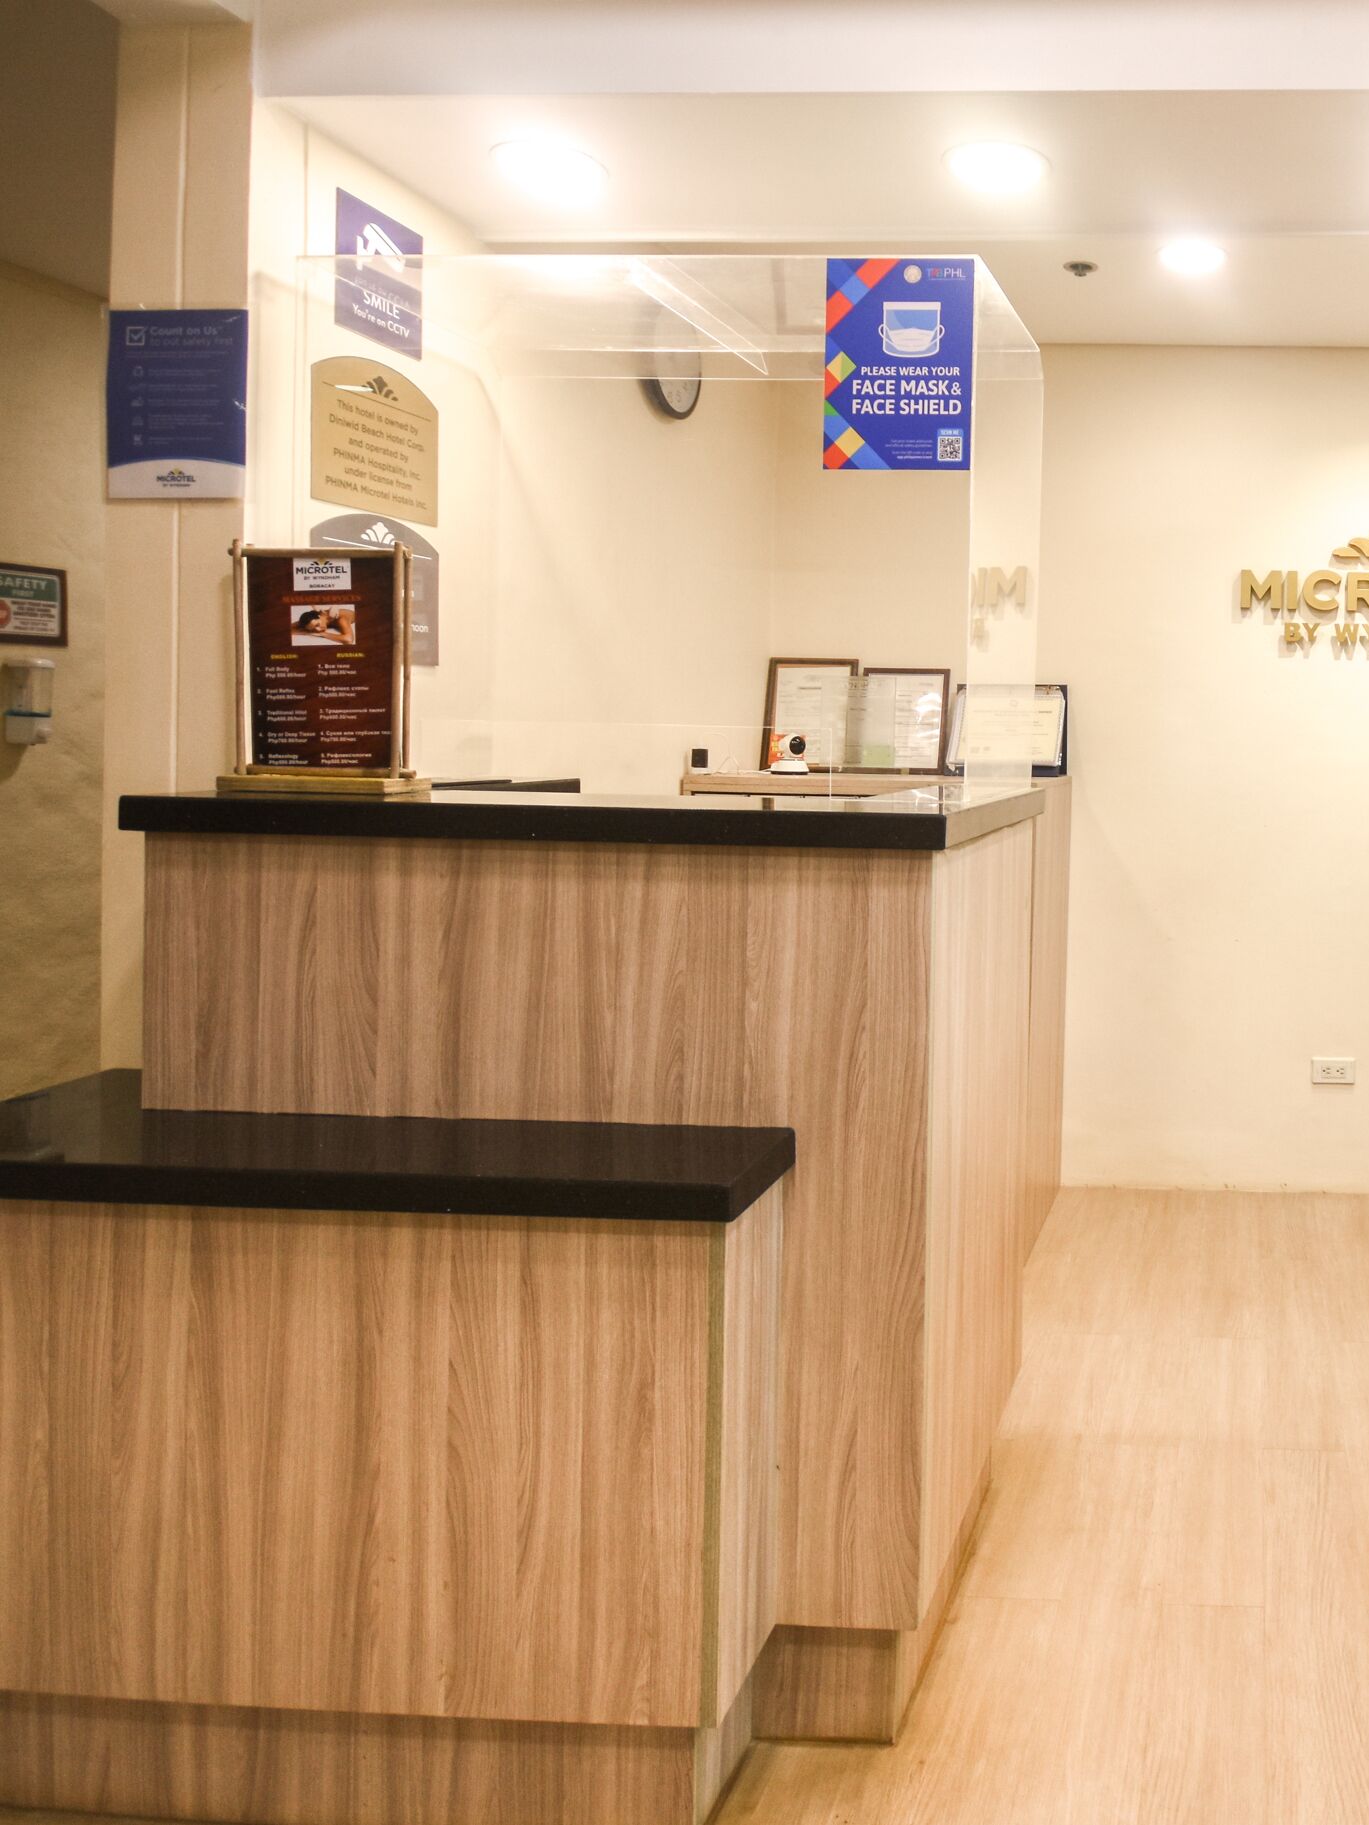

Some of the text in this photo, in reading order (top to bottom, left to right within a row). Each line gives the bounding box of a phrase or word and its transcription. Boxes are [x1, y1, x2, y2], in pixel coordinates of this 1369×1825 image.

[363, 290, 400, 320] SMILE
[150, 326, 182, 336] Count
[186, 328, 200, 336] on
[352, 304, 410, 338] You're on CCTV
[861, 366, 960, 376] PLEASE WEAR YOUR
[852, 380, 962, 395] FACE MASK &
[336, 399, 418, 436] This hotel is owned by
[852, 399, 962, 415] FACE SHIELD
[329, 413, 359, 431] Diniwid
[361, 424, 384, 439] Beach
[386, 432, 405, 445] Hotel
[333, 448, 365, 464] PHINMA
[348, 437, 409, 463] and operated by
[344, 466, 412, 491] under license from
[325, 475, 358, 493] PHINMA
[360, 485, 390, 500] Microtel
[392, 494, 414, 506] Hotels
[296, 566, 347, 575] MICROTEL
[1284, 622, 1320, 643] BY
